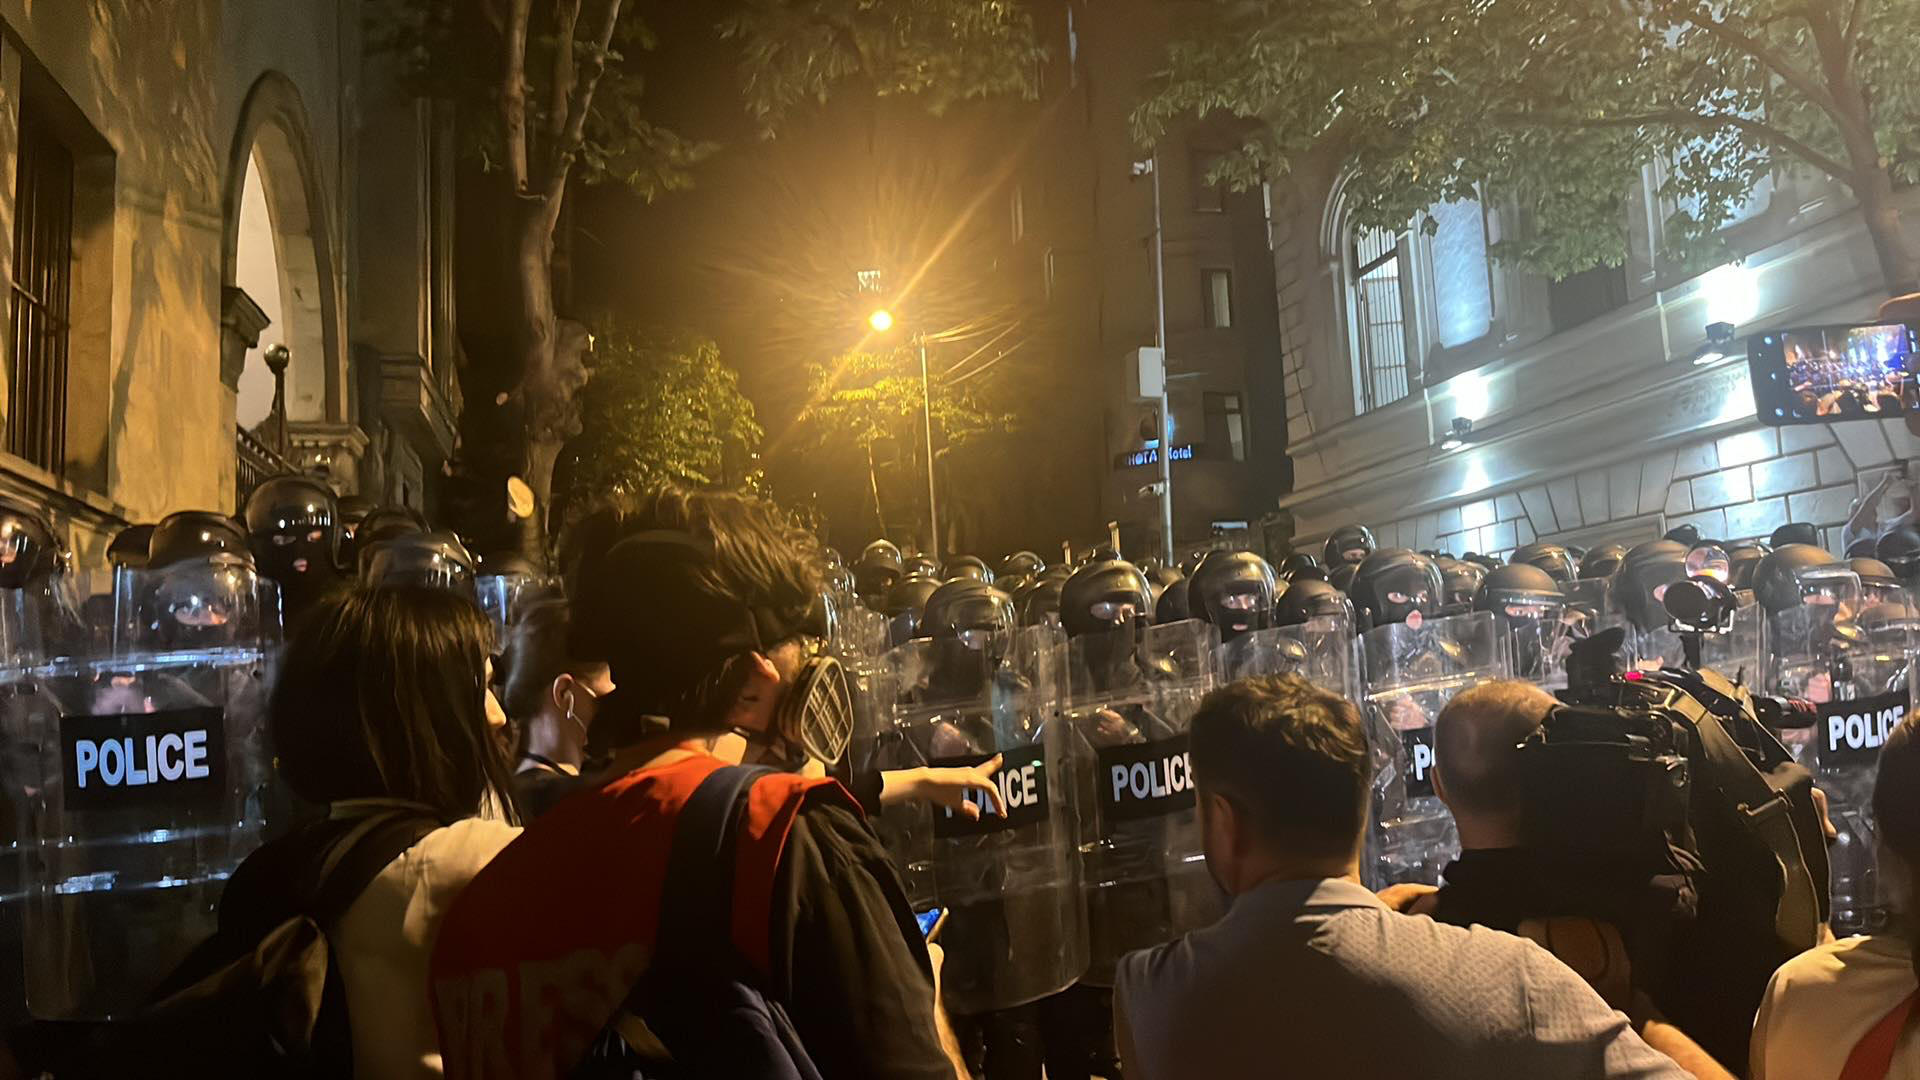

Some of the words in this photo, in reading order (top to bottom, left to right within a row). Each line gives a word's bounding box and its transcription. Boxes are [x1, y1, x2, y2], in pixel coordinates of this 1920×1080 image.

[76, 729, 209, 788] POLICE
[1111, 752, 1194, 802] POLICE
[945, 765, 1038, 818] LICE
